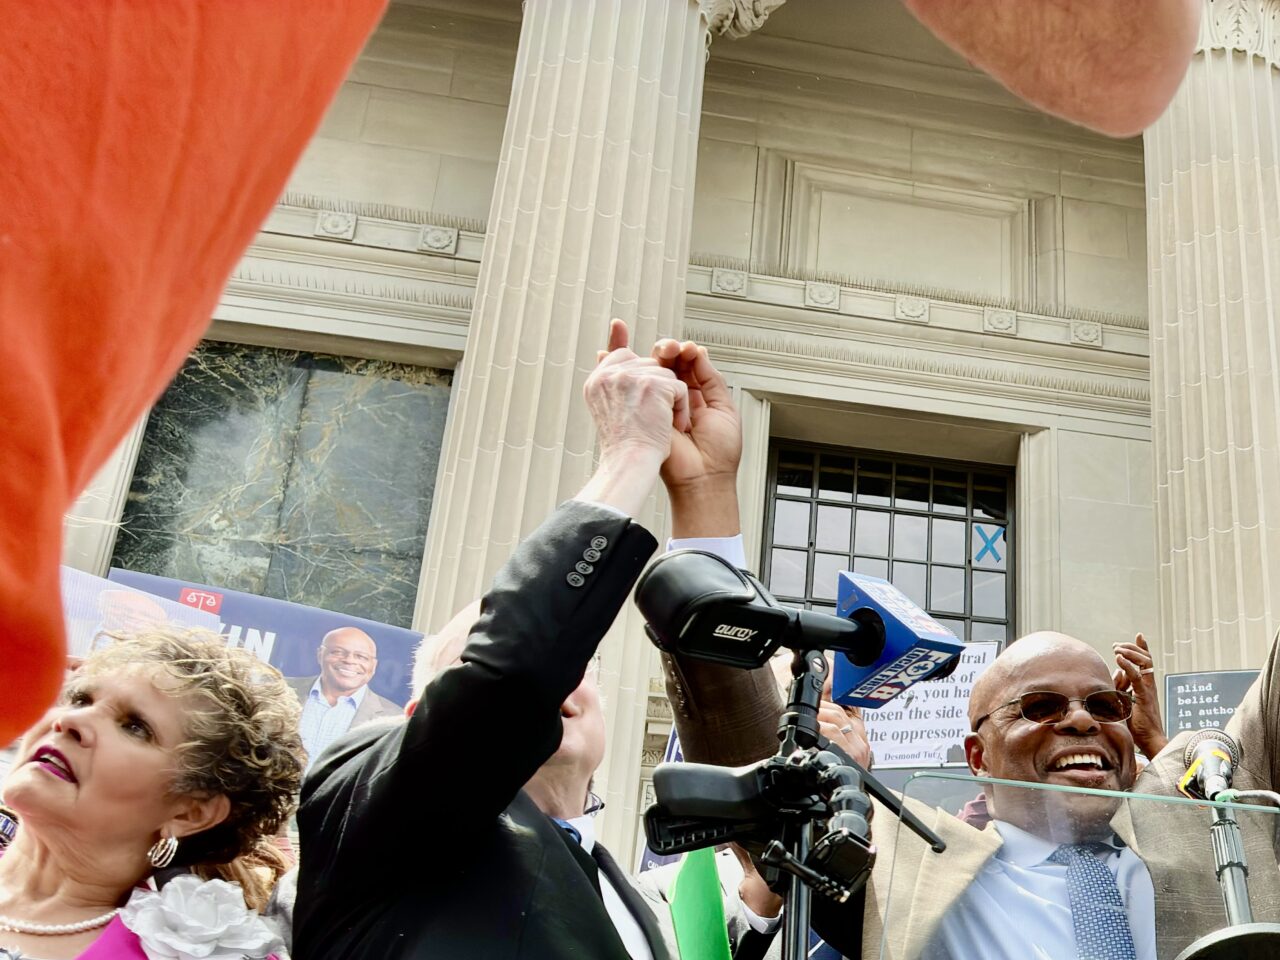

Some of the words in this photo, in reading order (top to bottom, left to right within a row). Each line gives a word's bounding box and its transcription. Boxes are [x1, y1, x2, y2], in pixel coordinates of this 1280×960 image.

[219, 622, 276, 664] IN
[888, 648, 928, 672] LOCAL
[960, 671, 976, 683] of
[854, 672, 890, 697] FIRST
[1177, 683, 1213, 693] Blind
[924, 689, 950, 702] you
[1177, 694, 1220, 705] belief
[908, 707, 931, 719] the
[935, 706, 963, 718] side
[1178, 708, 1192, 718] in
[1178, 720, 1192, 729] is
[1198, 719, 1220, 729] the
[891, 727, 965, 744] oppressor.
[884, 751, 920, 761] Desmond
